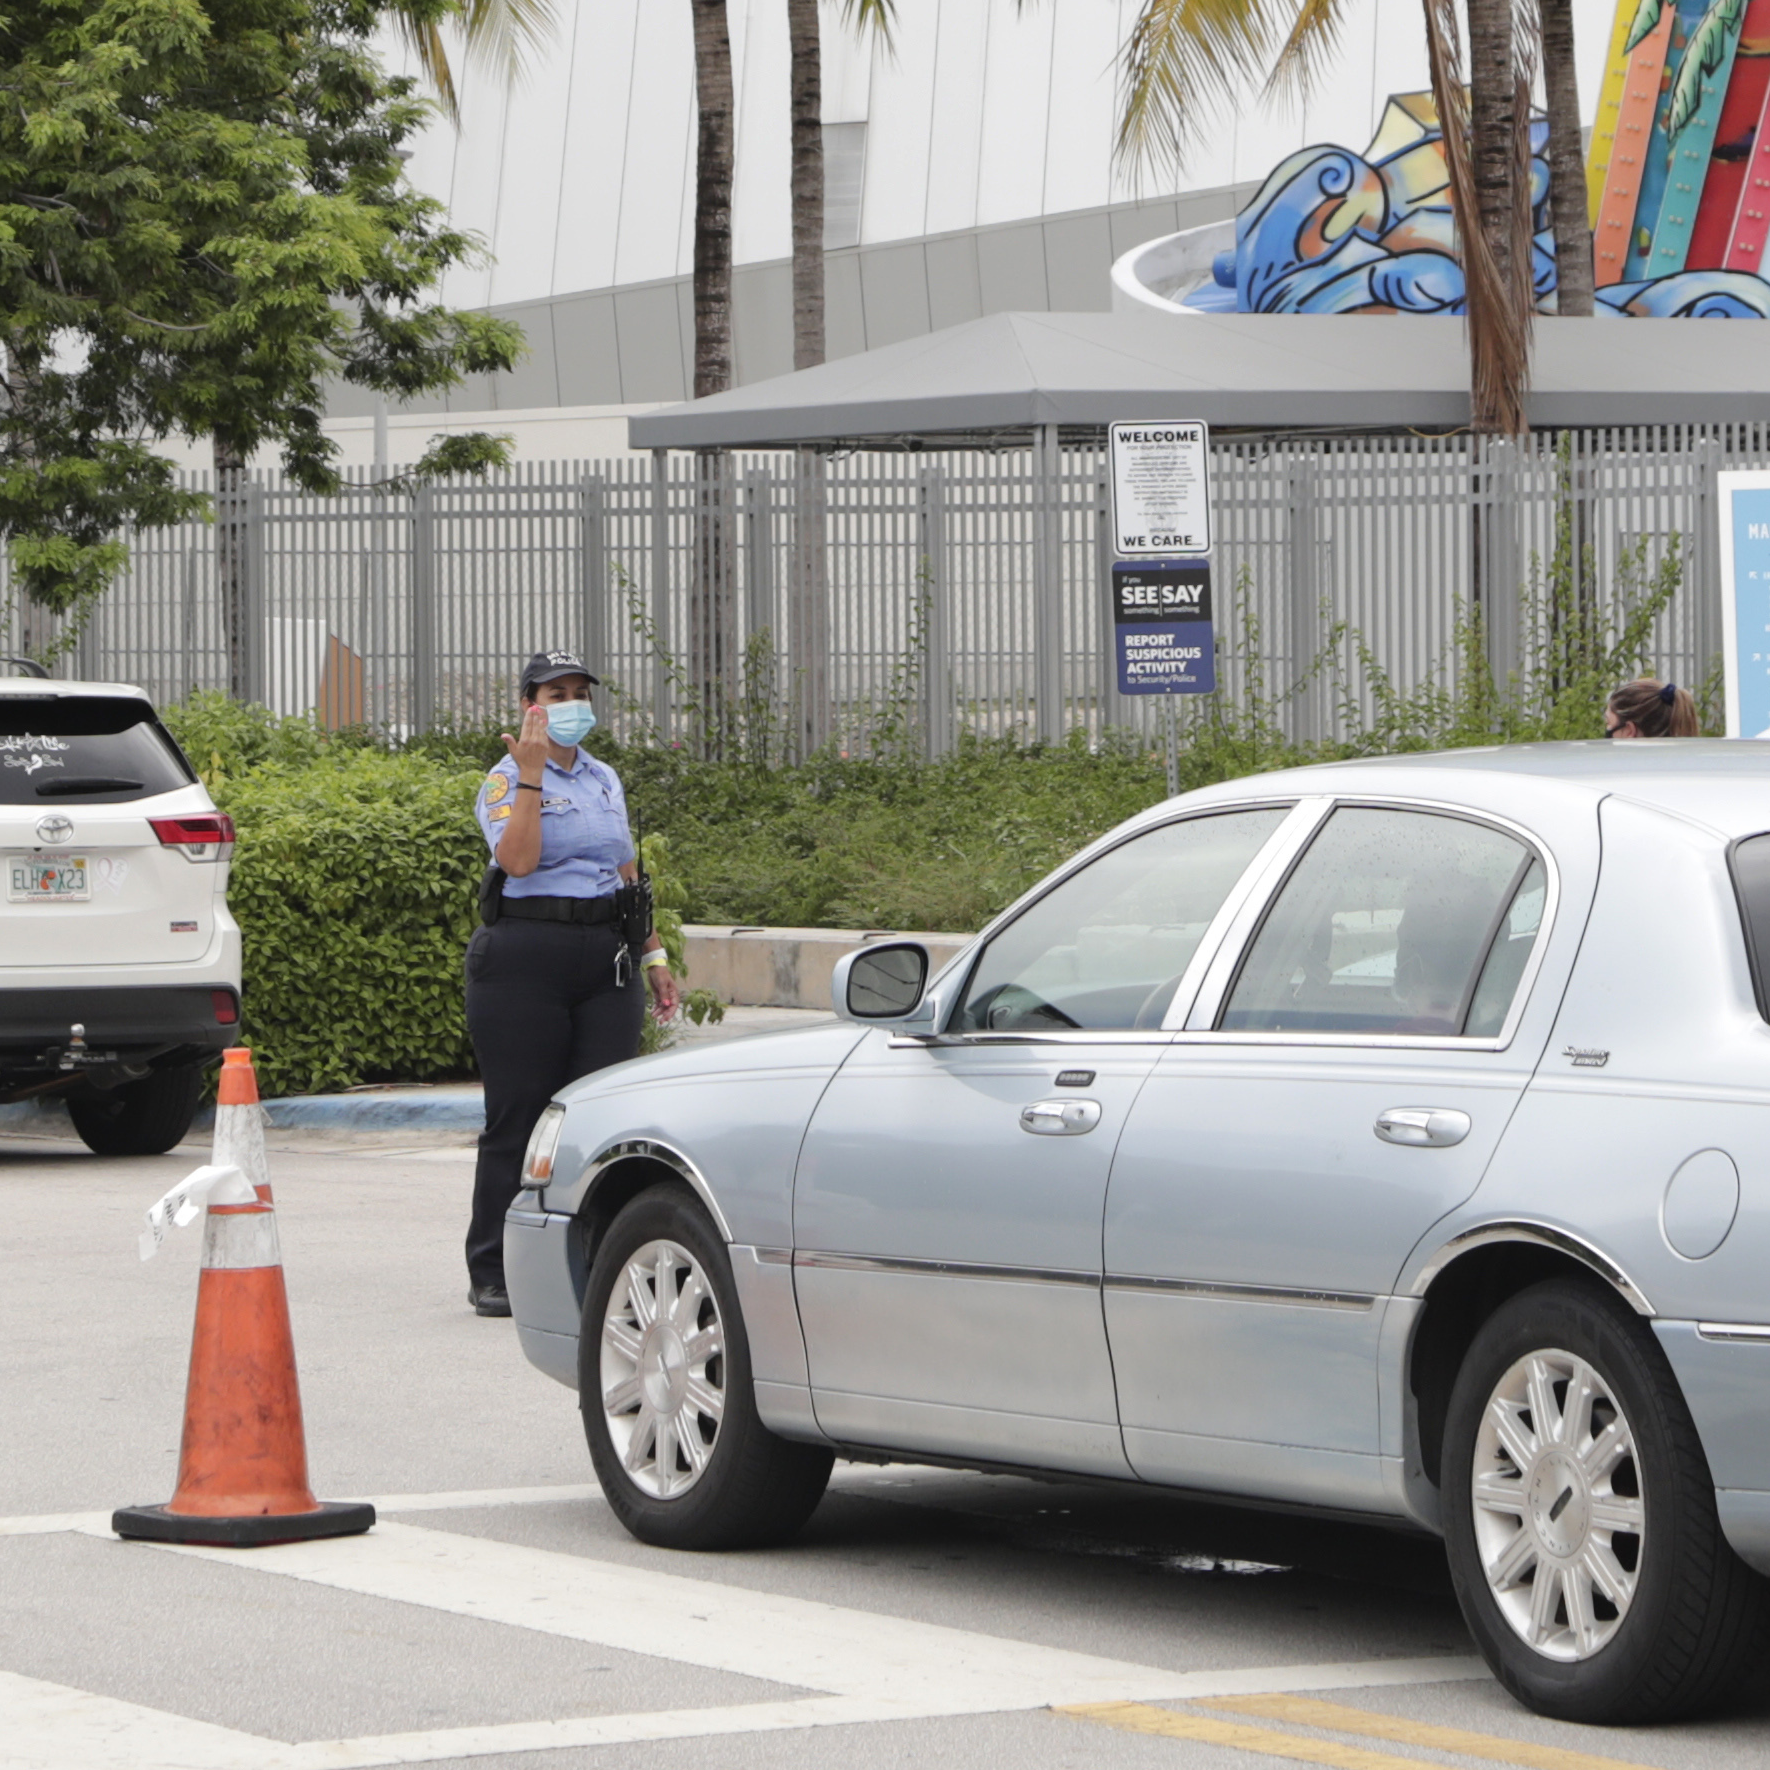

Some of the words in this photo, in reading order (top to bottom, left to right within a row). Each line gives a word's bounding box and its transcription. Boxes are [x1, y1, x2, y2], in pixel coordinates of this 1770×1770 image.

[1118, 430, 1199, 443] WELCOME
[1123, 536, 1146, 547] WE
[1121, 586, 1158, 605] SEE
[1162, 584, 1204, 604] SAY
[1125, 634, 1175, 647] REPORT
[1126, 647, 1202, 660] SUSPICIOUS
[1126, 661, 1187, 674] ACTIVITY
[1127, 675, 1137, 684] to
[12, 869, 40, 890] ELH
[57, 869, 85, 889] X23
